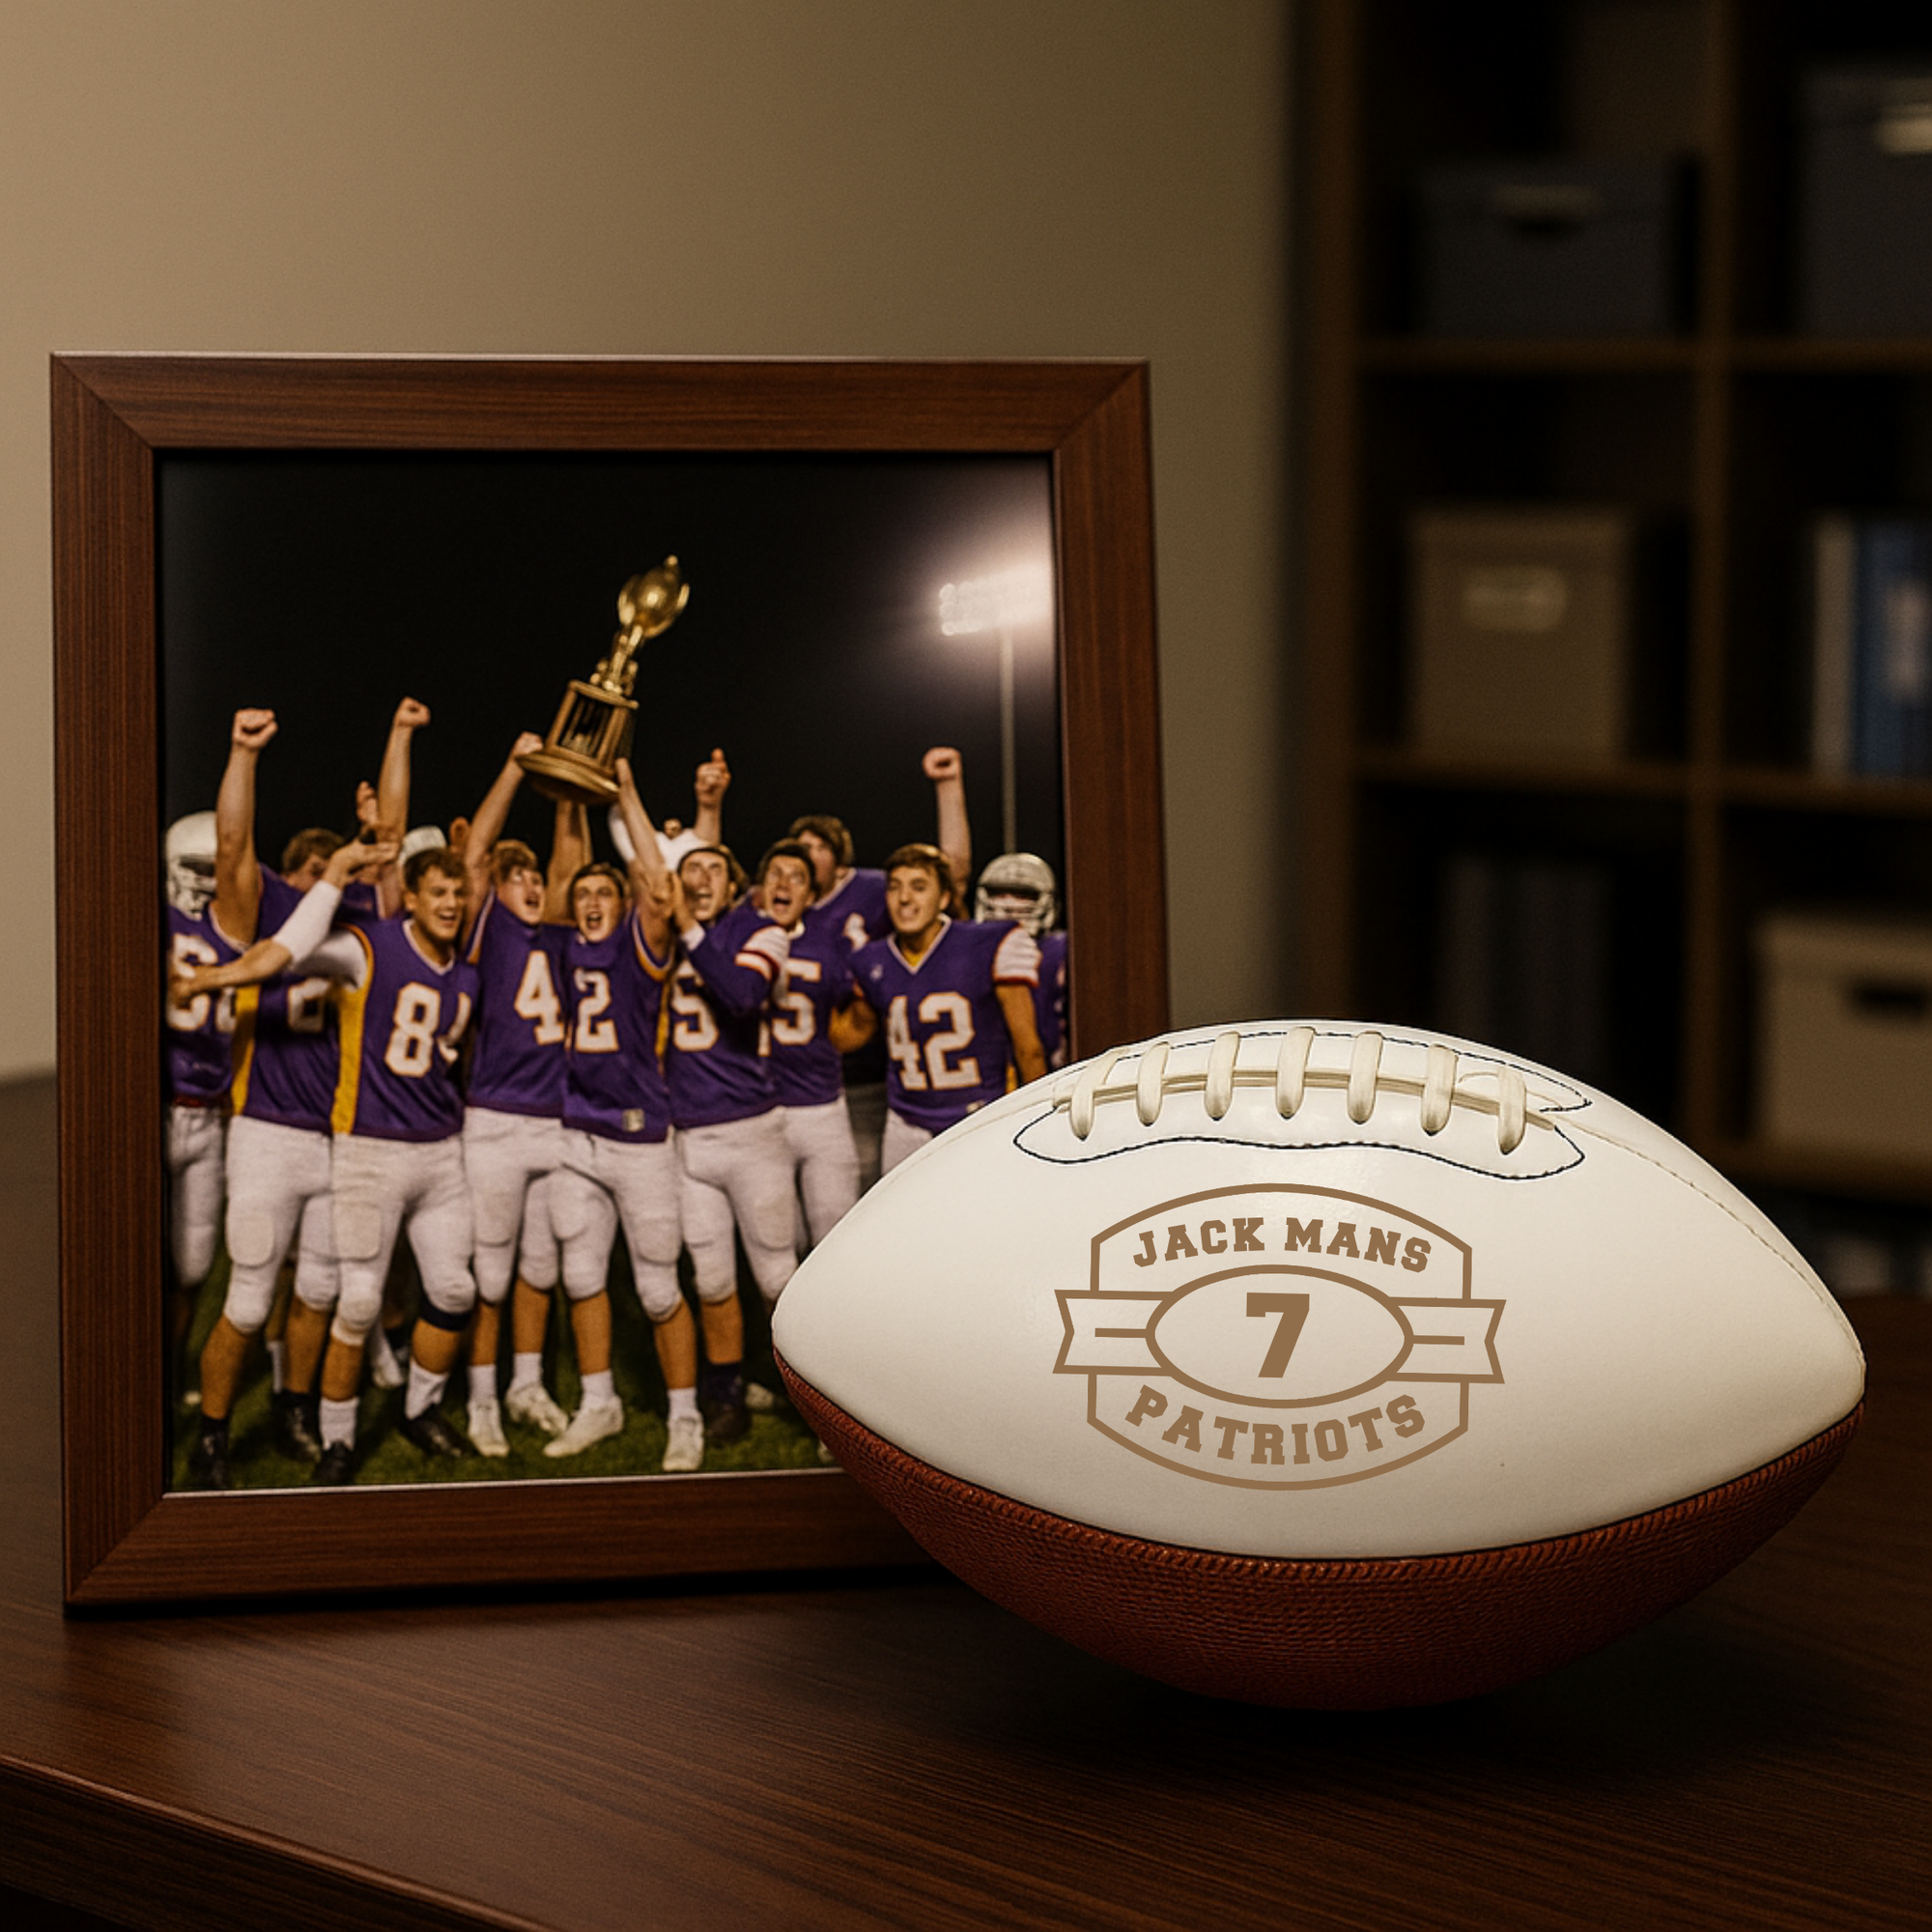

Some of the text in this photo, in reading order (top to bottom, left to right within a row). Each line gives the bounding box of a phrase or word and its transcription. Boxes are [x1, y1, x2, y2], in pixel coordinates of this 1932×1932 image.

[887, 991, 981, 1091] 42
[1133, 1217, 1432, 1273] JACK MANS
[1245, 1292, 1310, 1378] 7
[1124, 1384, 1426, 1465] PATRIOTS
